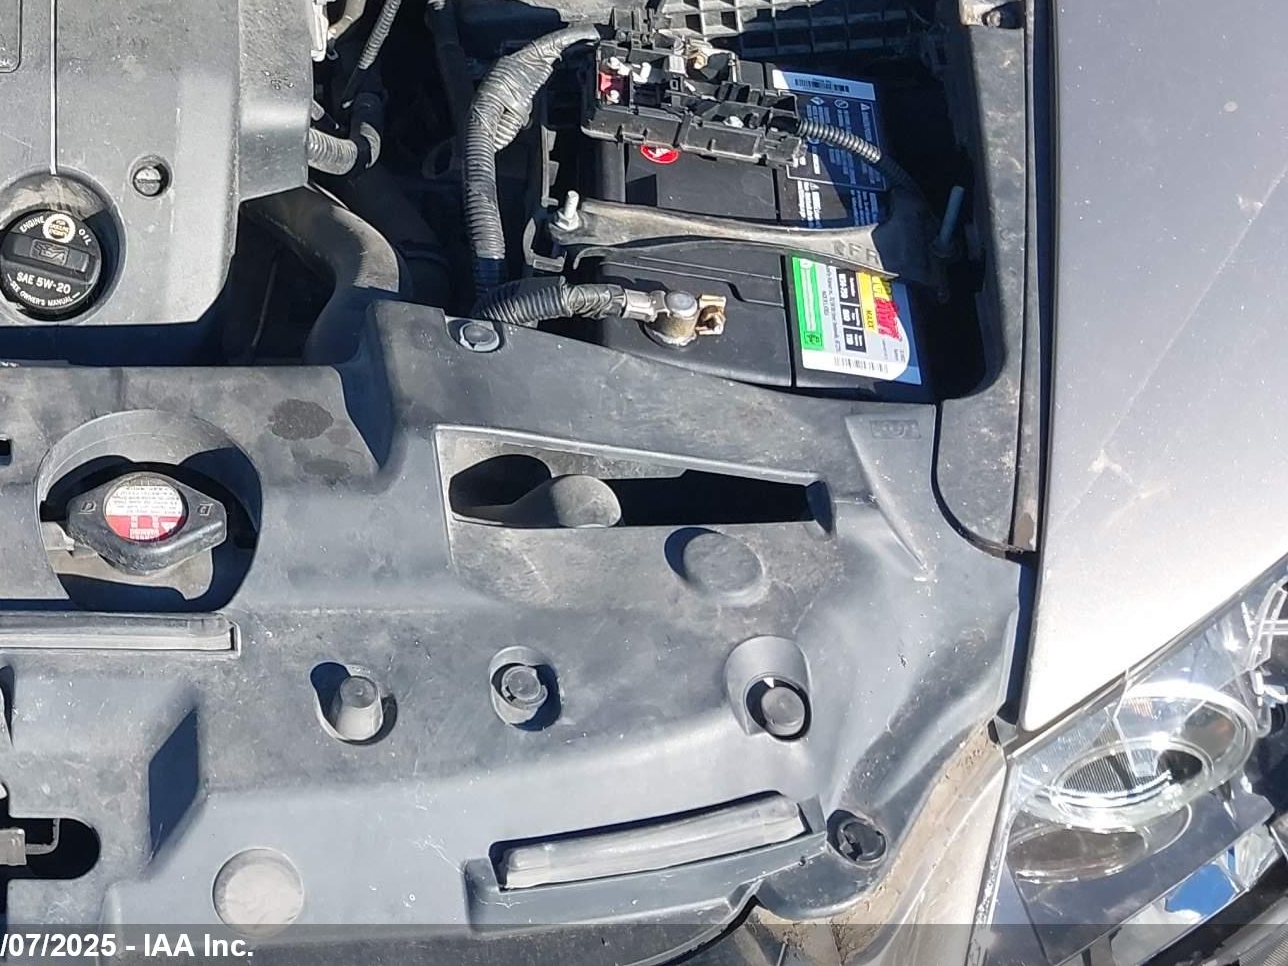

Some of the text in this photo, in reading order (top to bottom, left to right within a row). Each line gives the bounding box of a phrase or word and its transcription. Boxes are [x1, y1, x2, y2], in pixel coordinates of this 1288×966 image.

[19, 216, 45, 233] ENGINE
[78, 228, 92, 246] OIL
[16, 272, 71, 294] SAE 5W-20
[19, 290, 46, 306] OWNER'S
[47, 296, 73, 307] MANUAL
